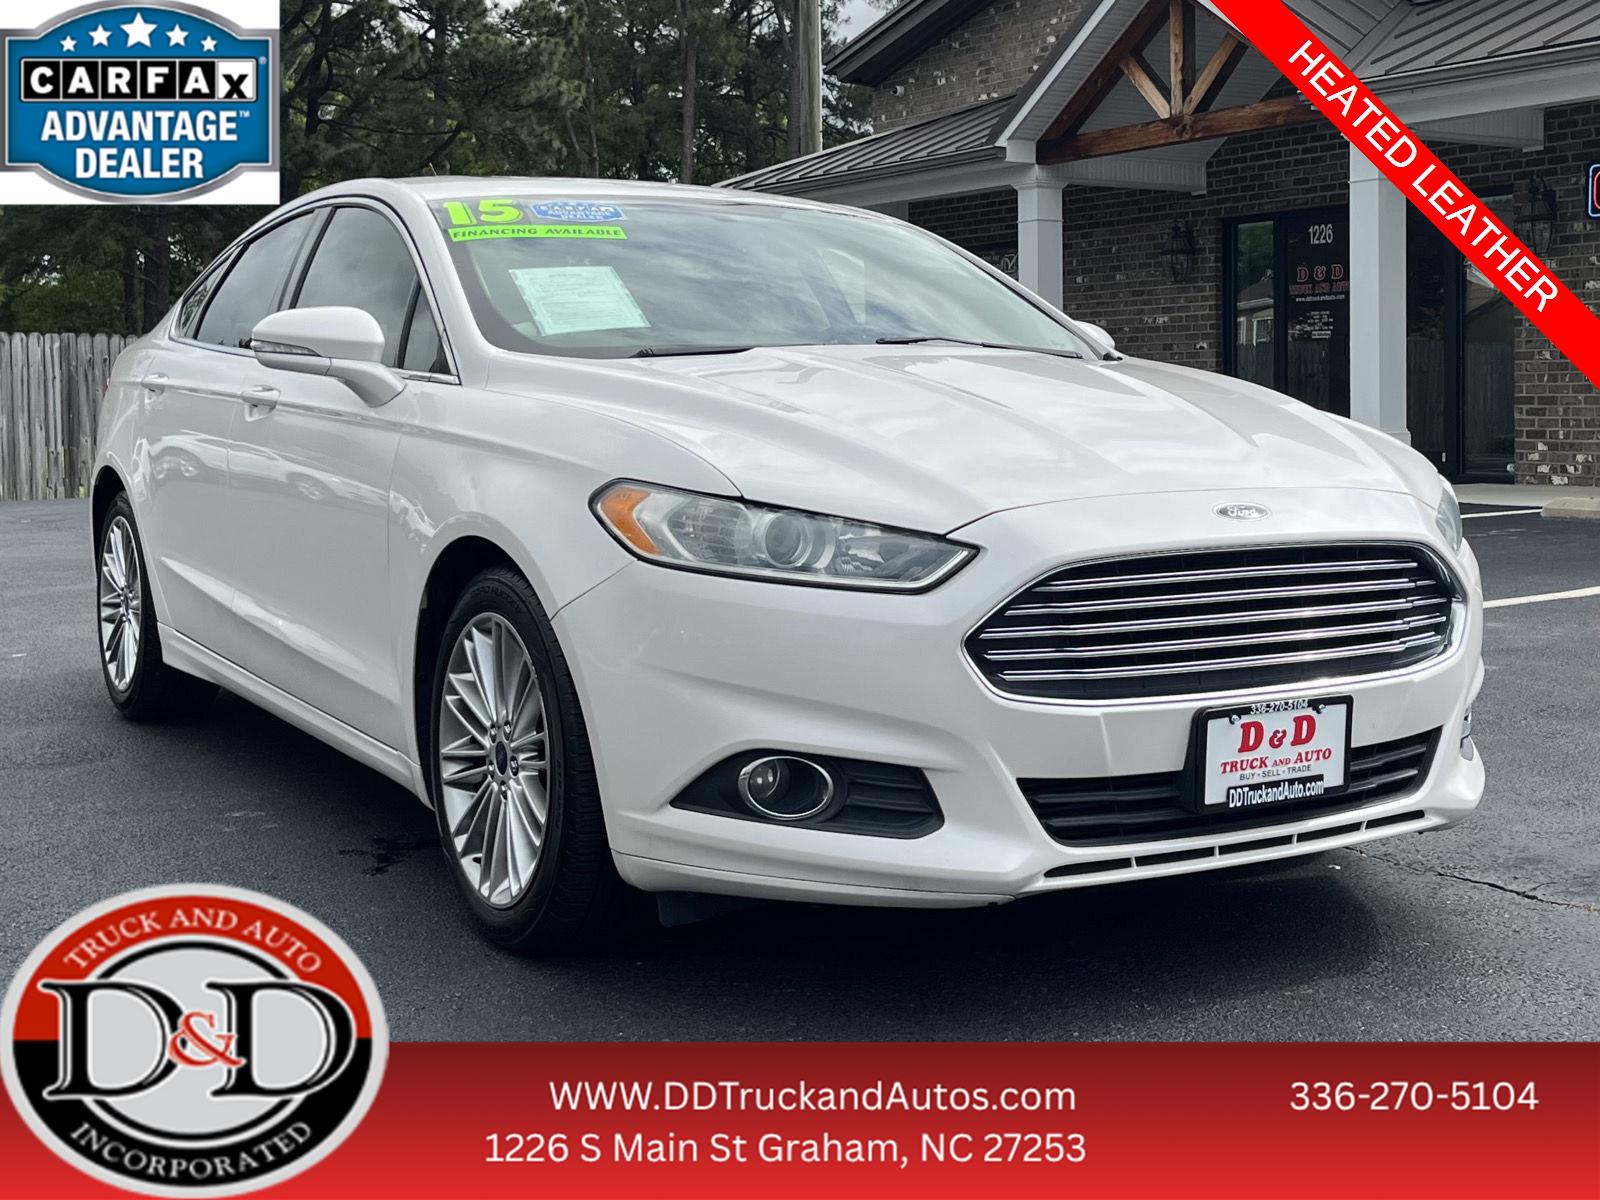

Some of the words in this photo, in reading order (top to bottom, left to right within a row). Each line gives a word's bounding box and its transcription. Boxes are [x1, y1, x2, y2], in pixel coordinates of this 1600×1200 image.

[442, 198, 525, 225] 15
[453, 227, 538, 239] FINANCING
[545, 228, 621, 236] AVAILABLE
[1309, 224, 1334, 245] 1226
[1250, 699, 1308, 714] 336-270-5104
[1220, 756, 1269, 775] TRUCK
[1272, 758, 1291, 767] AND
[1294, 748, 1332, 764] AUTO
[1239, 772, 1259, 781] BUY
[1262, 770, 1281, 778] SELL
[1287, 764, 1312, 774] TRADE
[1229, 780, 1324, 808] DDTruckandAuto.com
